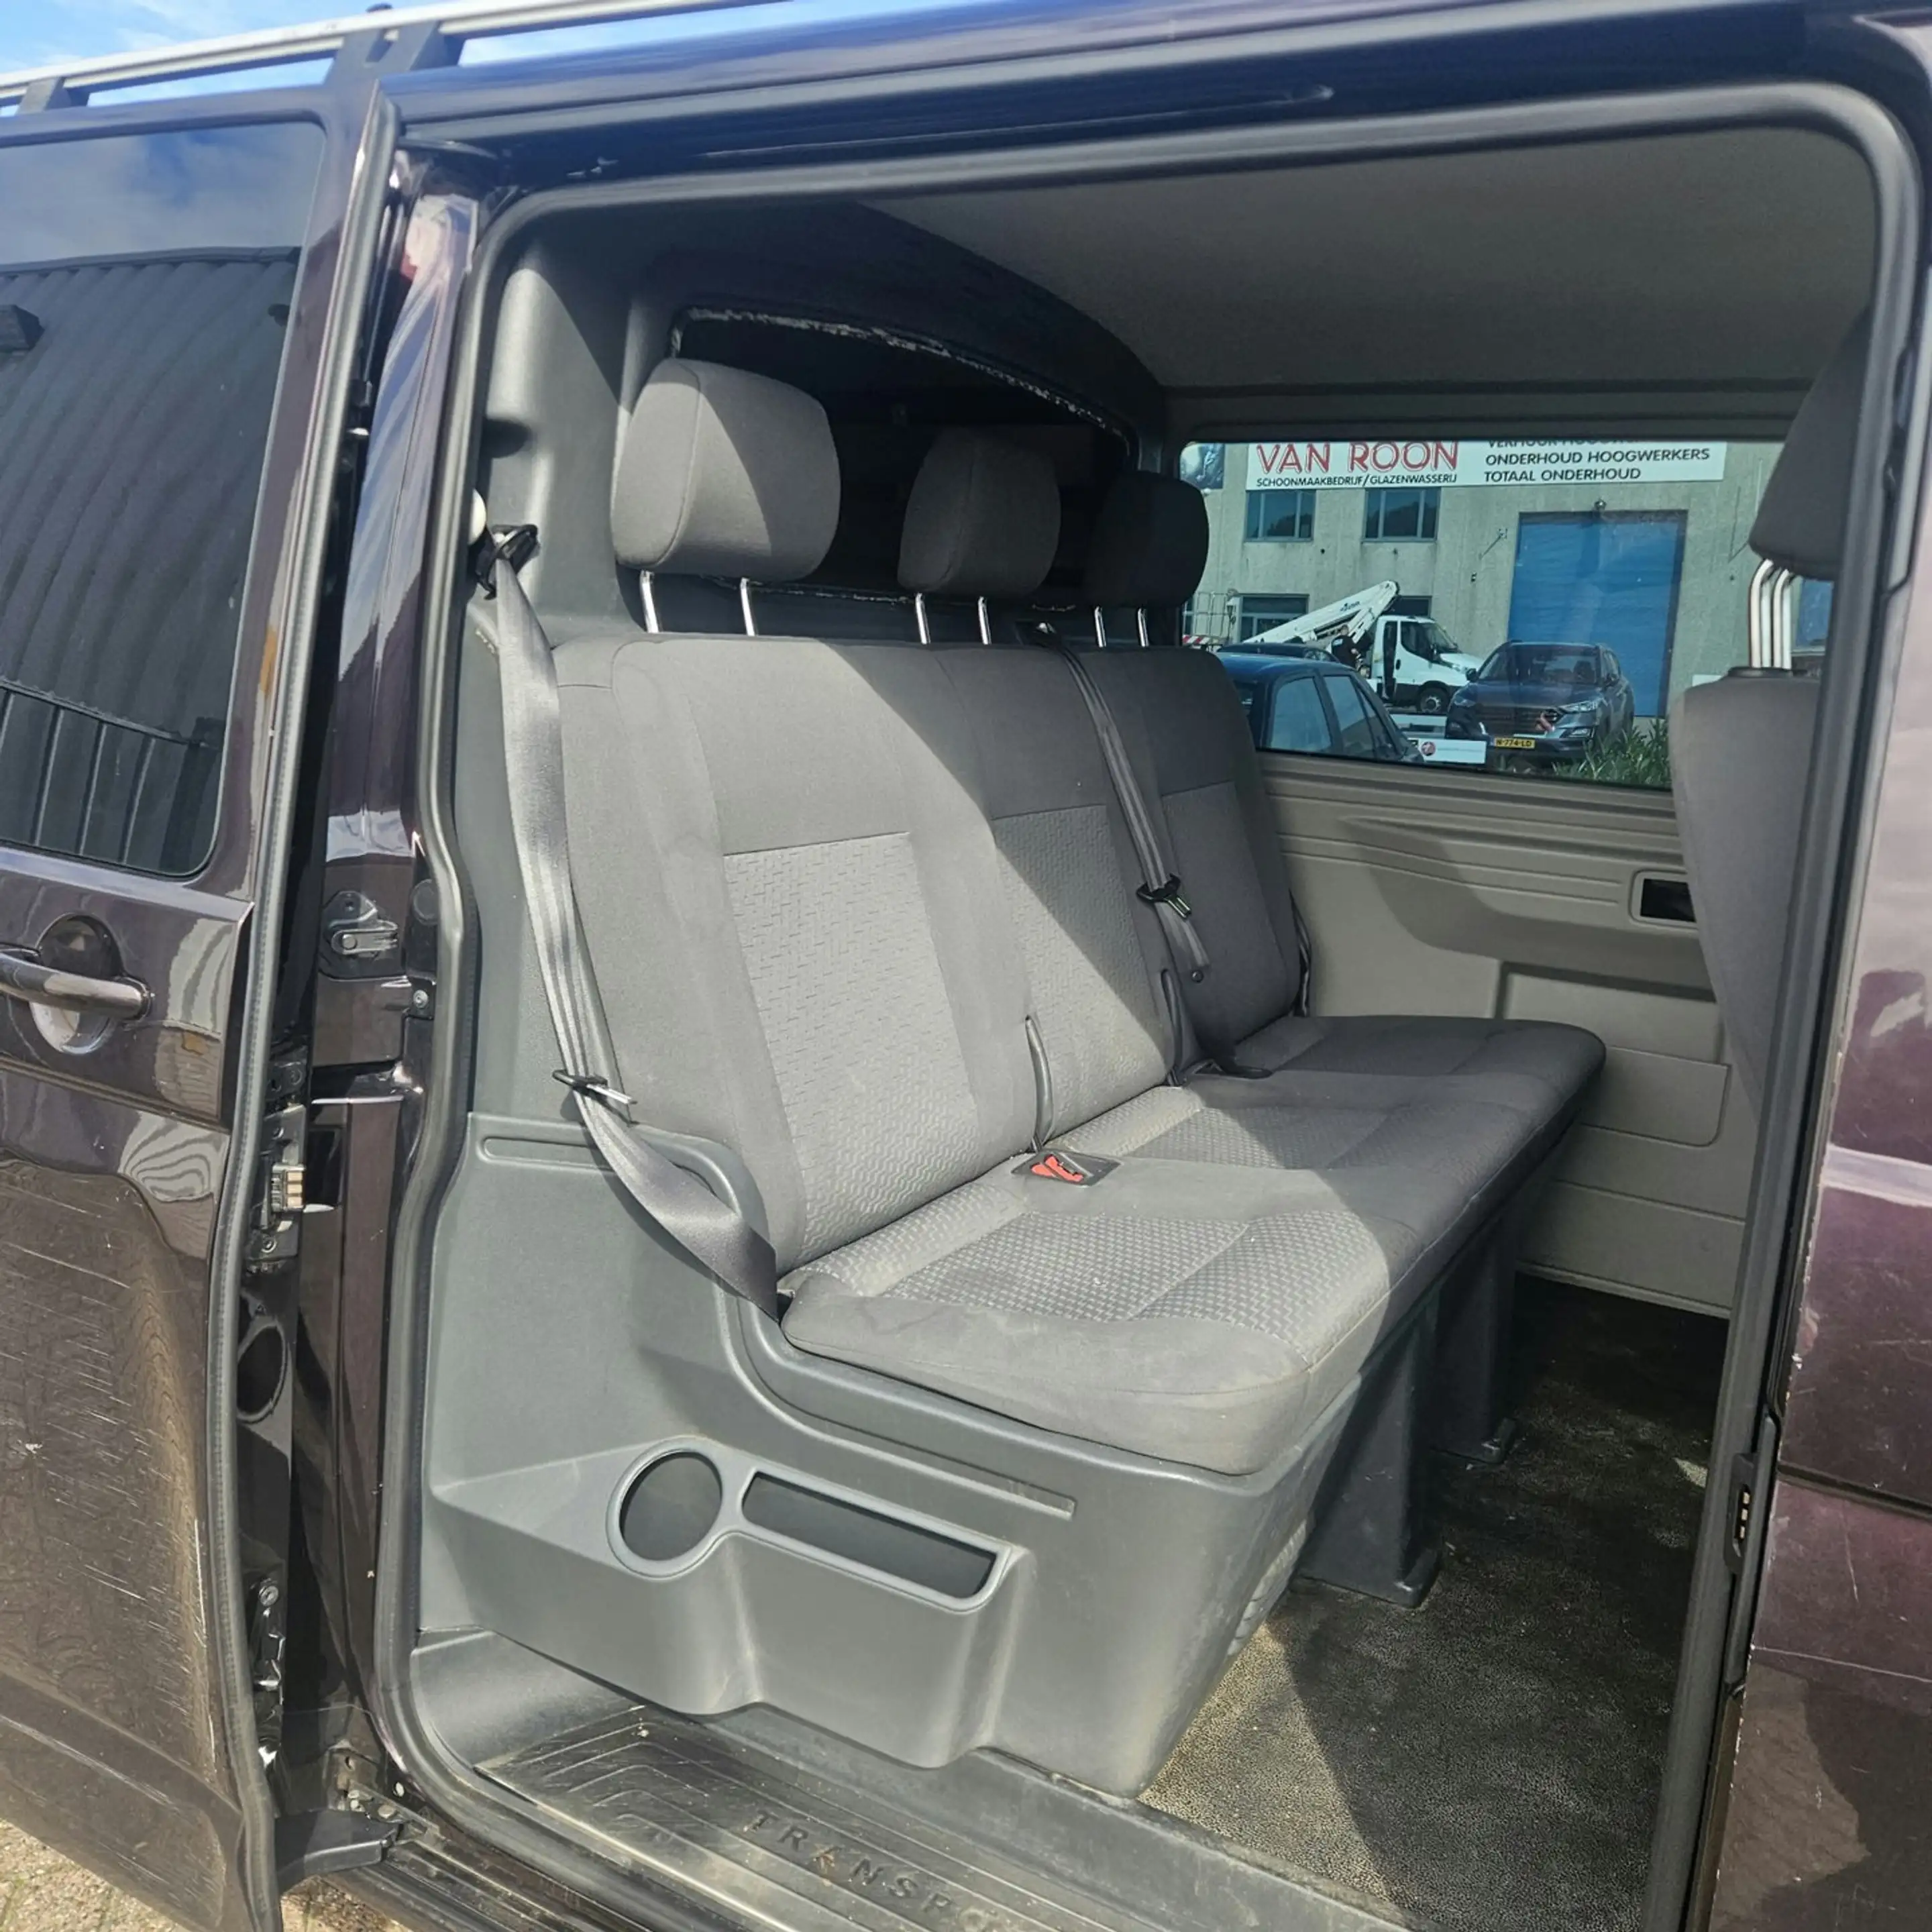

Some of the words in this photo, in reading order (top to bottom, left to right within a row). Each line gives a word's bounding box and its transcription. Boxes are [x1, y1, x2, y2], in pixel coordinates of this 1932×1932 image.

[1256, 442, 1330, 474] VAN
[1347, 441, 1458, 473] ROON
[1485, 451, 1583, 466] ONDERHOUD
[1587, 447, 1710, 464] HOOGWERKERS
[1484, 470, 1536, 482] TOTAAL
[1541, 468, 1642, 481] ONDERHOUD
